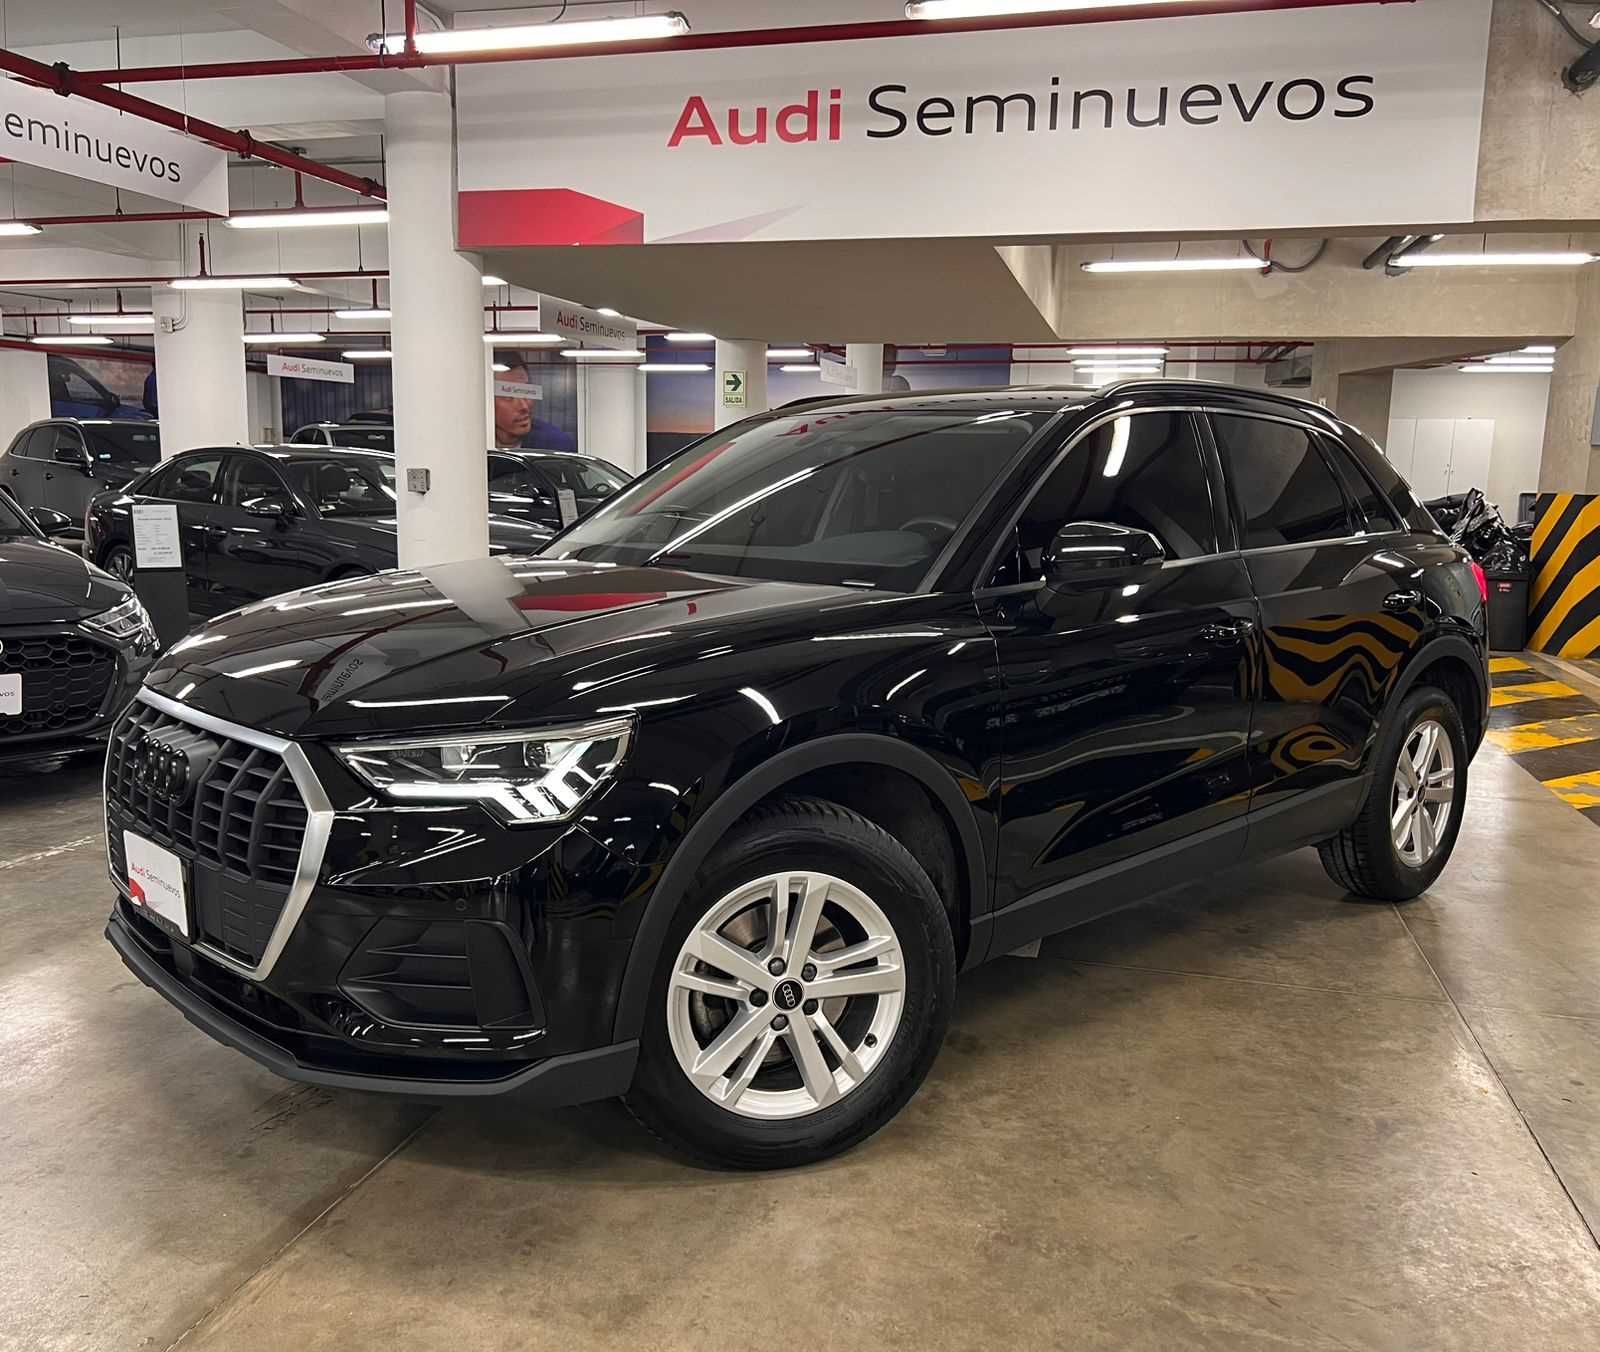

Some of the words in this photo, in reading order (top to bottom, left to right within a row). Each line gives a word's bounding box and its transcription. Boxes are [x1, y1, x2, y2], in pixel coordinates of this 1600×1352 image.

[667, 88, 841, 147] Audi
[865, 74, 1375, 139] Seminuevos
[4, 112, 181, 183] eminuevos
[556, 311, 578, 329] Audi
[580, 316, 626, 339] Seminuevos
[281, 361, 300, 373] Audi
[301, 364, 344, 377] Seminuevos
